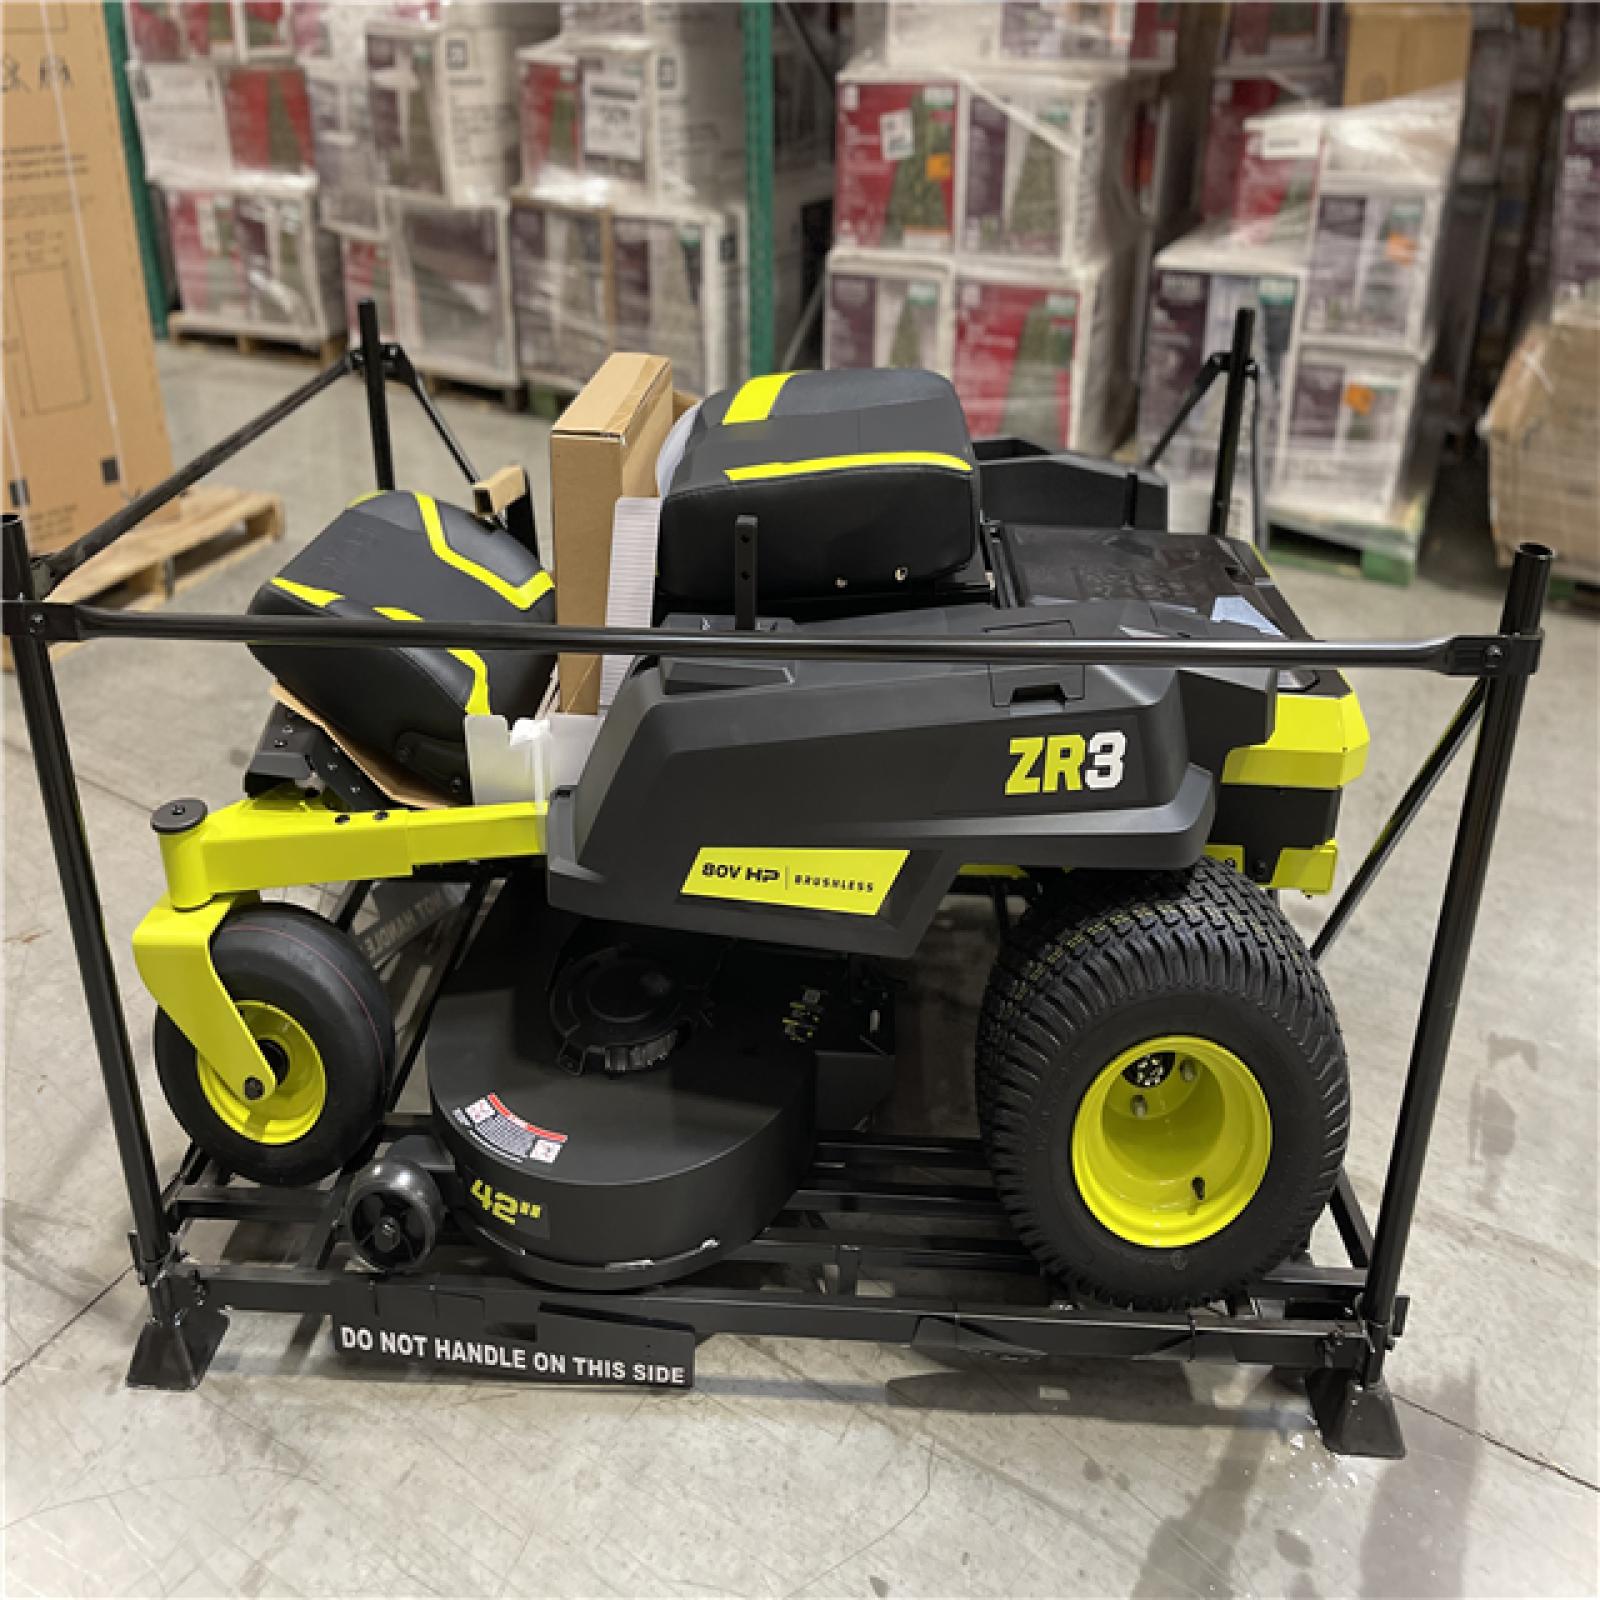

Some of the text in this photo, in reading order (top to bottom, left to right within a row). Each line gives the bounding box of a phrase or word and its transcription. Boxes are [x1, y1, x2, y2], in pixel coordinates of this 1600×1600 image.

[1005, 732, 1126, 795] ZR3
[702, 862, 874, 893] 80V HP BRUSHLESS
[470, 1179, 541, 1225] 42"
[340, 1325, 686, 1384] DO NOT HANDLE ON THIS SIDE
